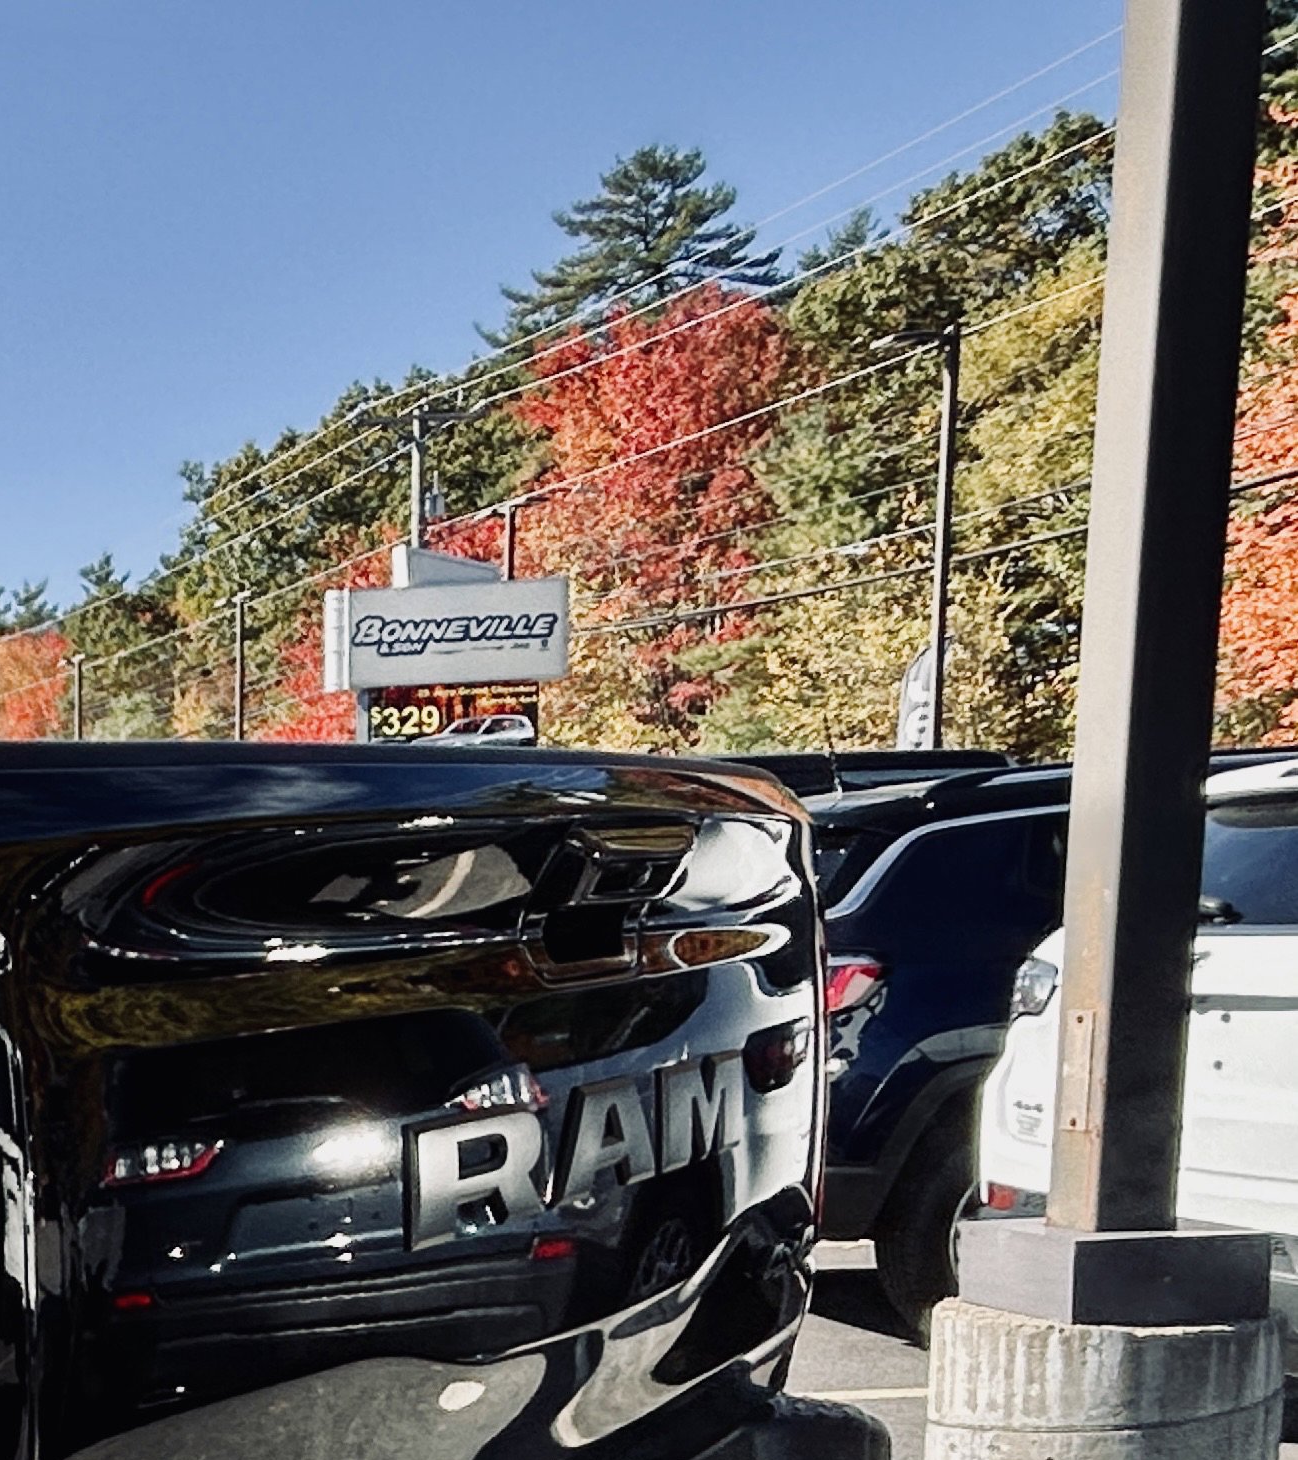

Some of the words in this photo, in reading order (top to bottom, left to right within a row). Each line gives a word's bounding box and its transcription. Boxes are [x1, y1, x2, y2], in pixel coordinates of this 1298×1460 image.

[352, 613, 558, 647] BONNEVILLE
[370, 704, 440, 737] $329
[402, 1049, 747, 1252] RAM
